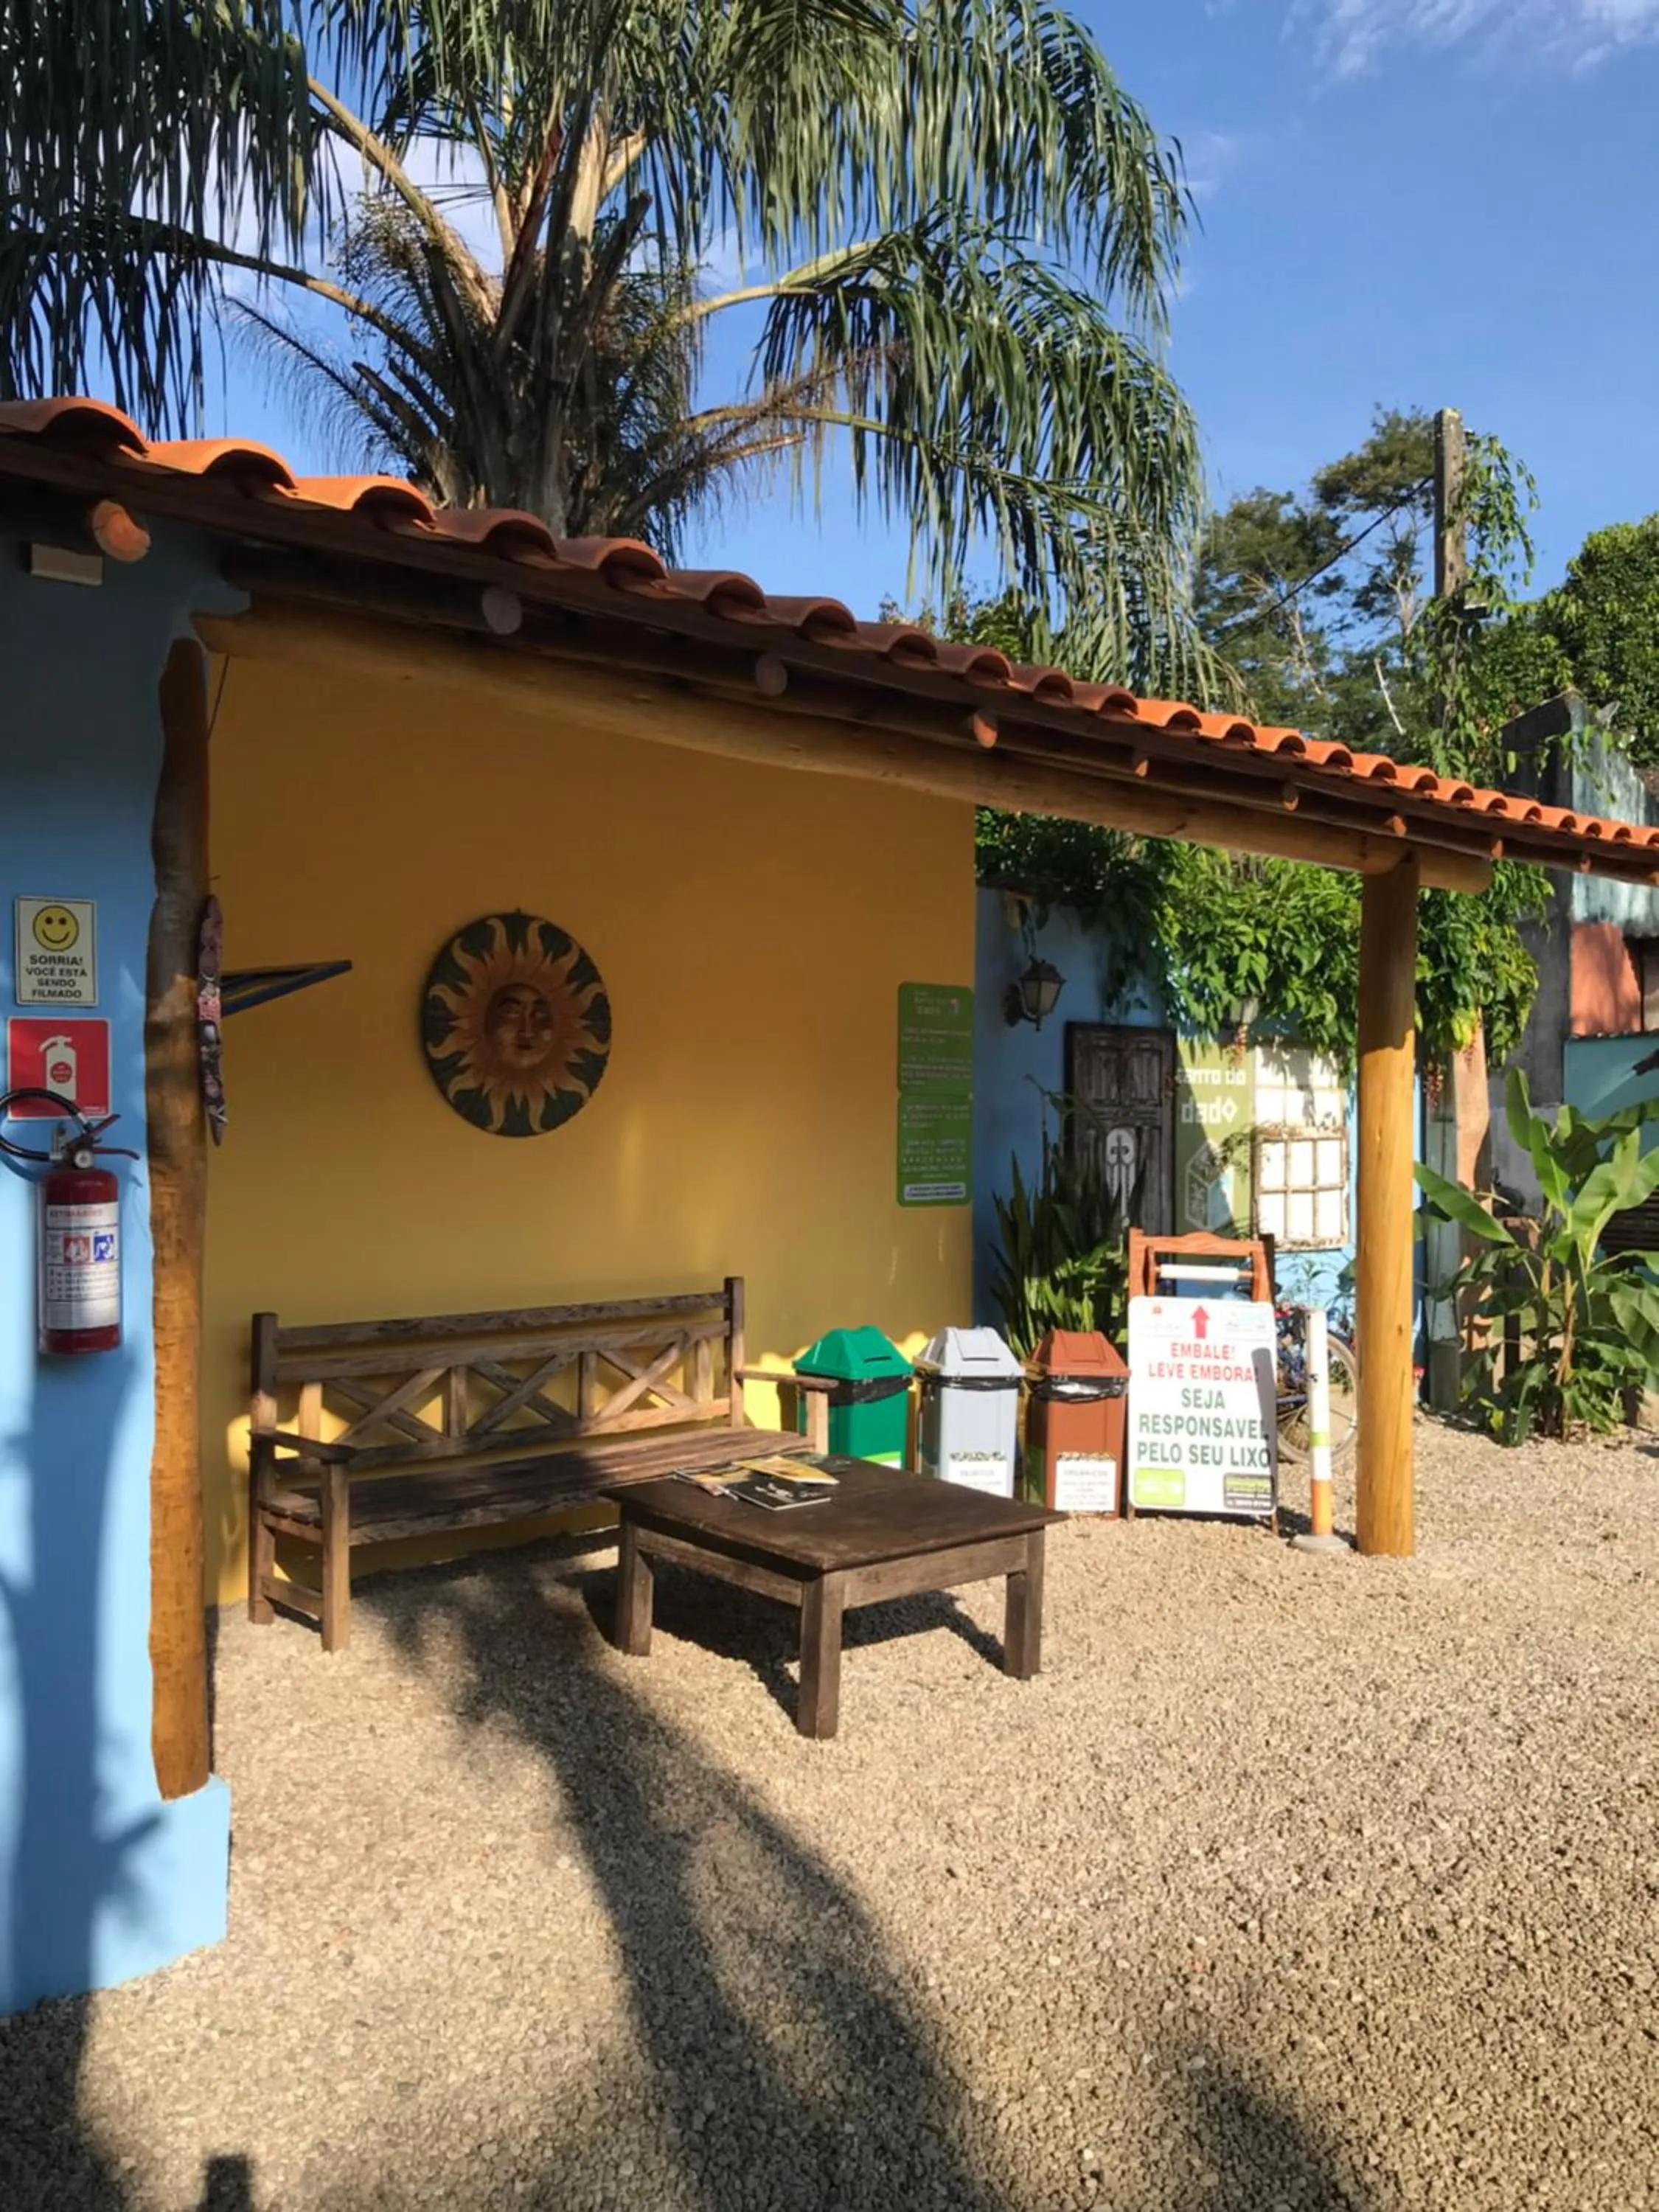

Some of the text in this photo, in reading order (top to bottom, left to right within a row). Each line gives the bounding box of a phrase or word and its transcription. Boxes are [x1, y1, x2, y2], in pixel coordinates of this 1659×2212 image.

[29, 955, 83, 965] SORRIA!
[37, 978, 76, 987] SENDO
[32, 990, 83, 998] FILMADO
[1225, 1069, 1246, 1085] do
[1170, 1342, 1236, 1360] EMBALE!
[1148, 1362, 1259, 1383] LEVE EMBORA!
[1181, 1388, 1225, 1410] SEJA
[1136, 1441, 1271, 1469] PELO SEU LIXO
